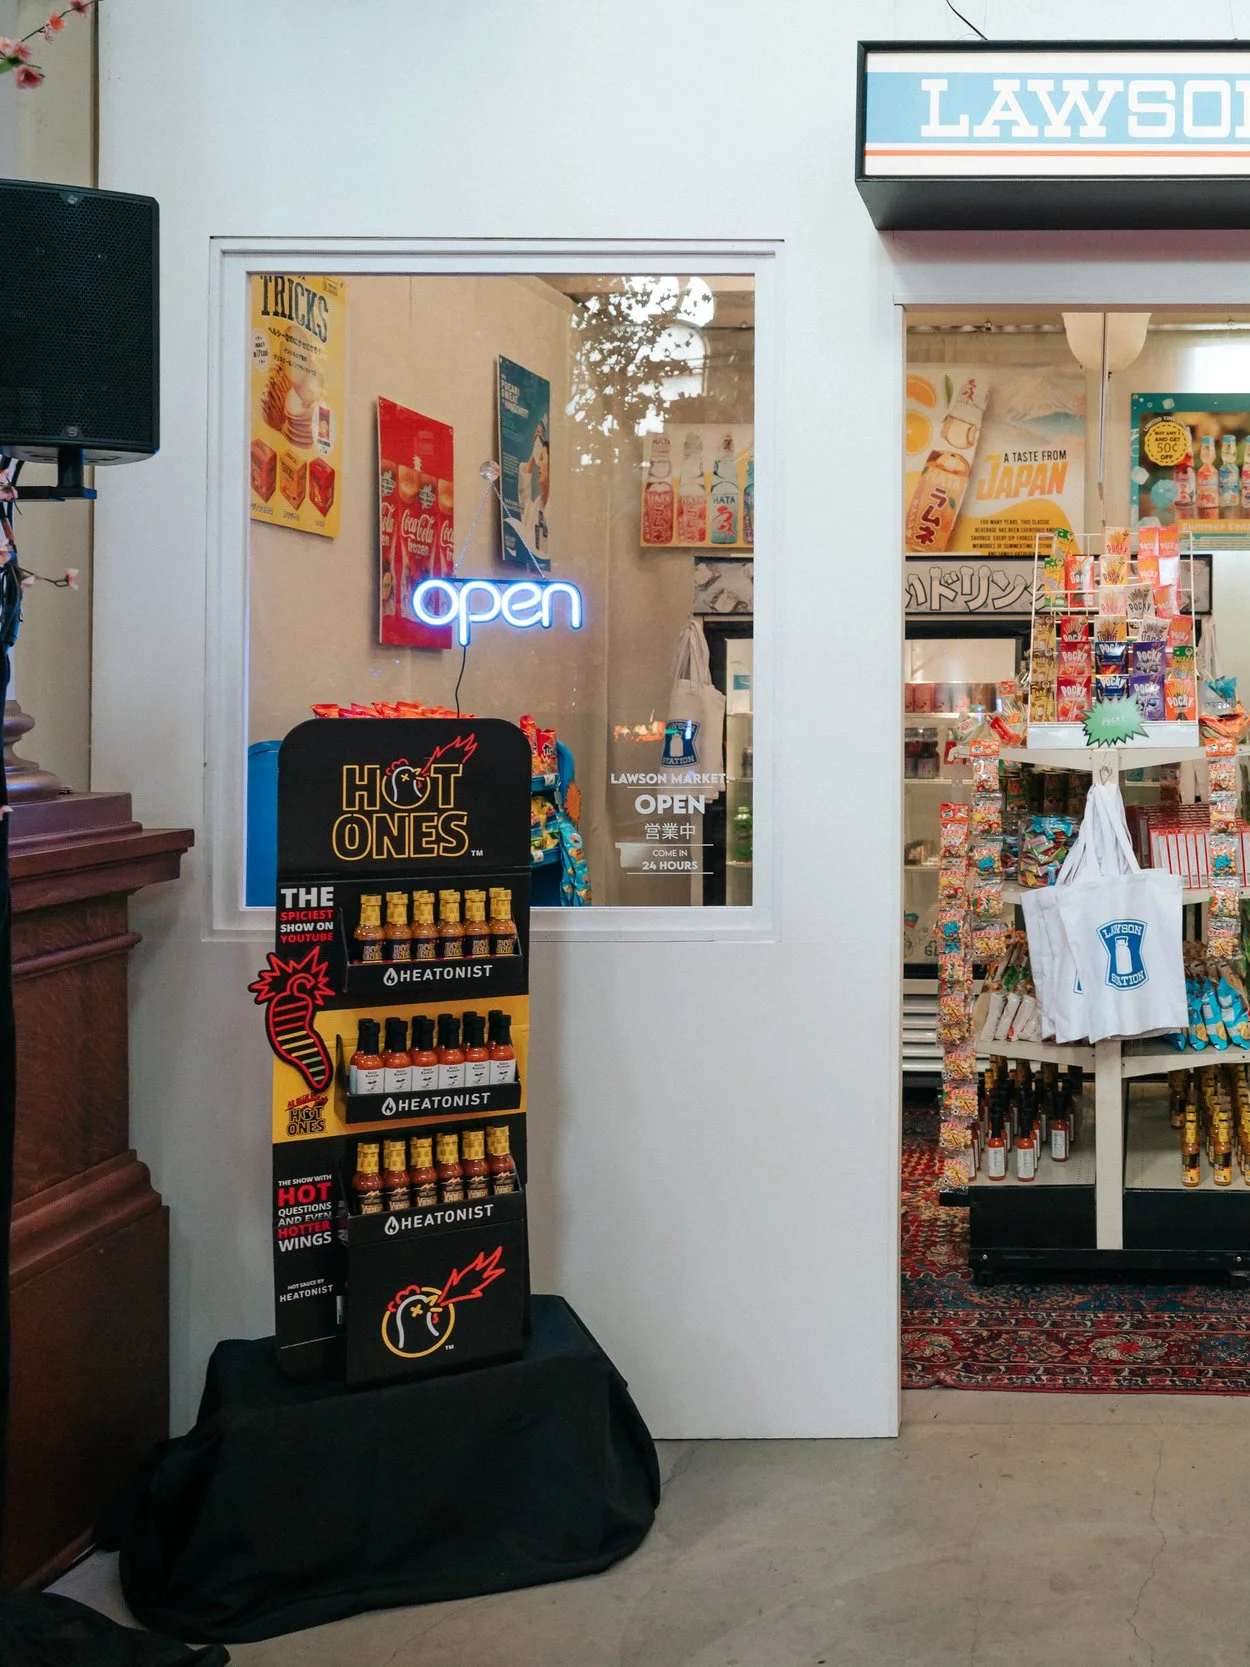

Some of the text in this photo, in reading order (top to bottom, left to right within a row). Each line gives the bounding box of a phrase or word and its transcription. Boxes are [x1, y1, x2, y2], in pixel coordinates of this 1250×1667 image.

[260, 275, 329, 343] TRICKS
[1004, 450, 1067, 463] A TASTE FROM
[976, 453, 1069, 500] JAPAN
[914, 487, 948, 545] ラムネ
[412, 579, 583, 648] open
[1128, 601, 1151, 613] POCKY
[1063, 650, 1088, 663] POCKY
[1137, 650, 1162, 663] POCKY
[1060, 685, 1087, 698] POCKY
[1100, 677, 1127, 689] POCKY
[1167, 696, 1193, 708] POCKY
[343, 763, 463, 811] HOT
[611, 773, 668, 784] LAWSON
[634, 794, 706, 815] OPEN
[332, 811, 469, 861] ONES
[644, 823, 696, 840] 営業中
[652, 849, 688, 857] COME IN
[642, 861, 698, 871] 24 HOURS
[280, 886, 335, 909] THE
[280, 909, 335, 921] SPICIEST
[280, 921, 334, 933] SHOW ON
[280, 932, 334, 944] YOUTUBE
[400, 965, 493, 983] HEATONIST
[398, 1092, 491, 1112] HEATONIST
[289, 1105, 324, 1123] HOT
[286, 1118, 327, 1137] ONES
[278, 1174, 332, 1187] THE SHOW WITH
[277, 1181, 332, 1207] HOT
[278, 1202, 332, 1217] QUESTIONS
[401, 1204, 494, 1230] HEATONIST
[278, 1211, 332, 1227] AND EVEN
[278, 1220, 331, 1239] HOTTER
[278, 1231, 332, 1253] WINGS
[299, 1280, 317, 1288] SAUCE
[279, 1284, 334, 1303] HEATONIST
